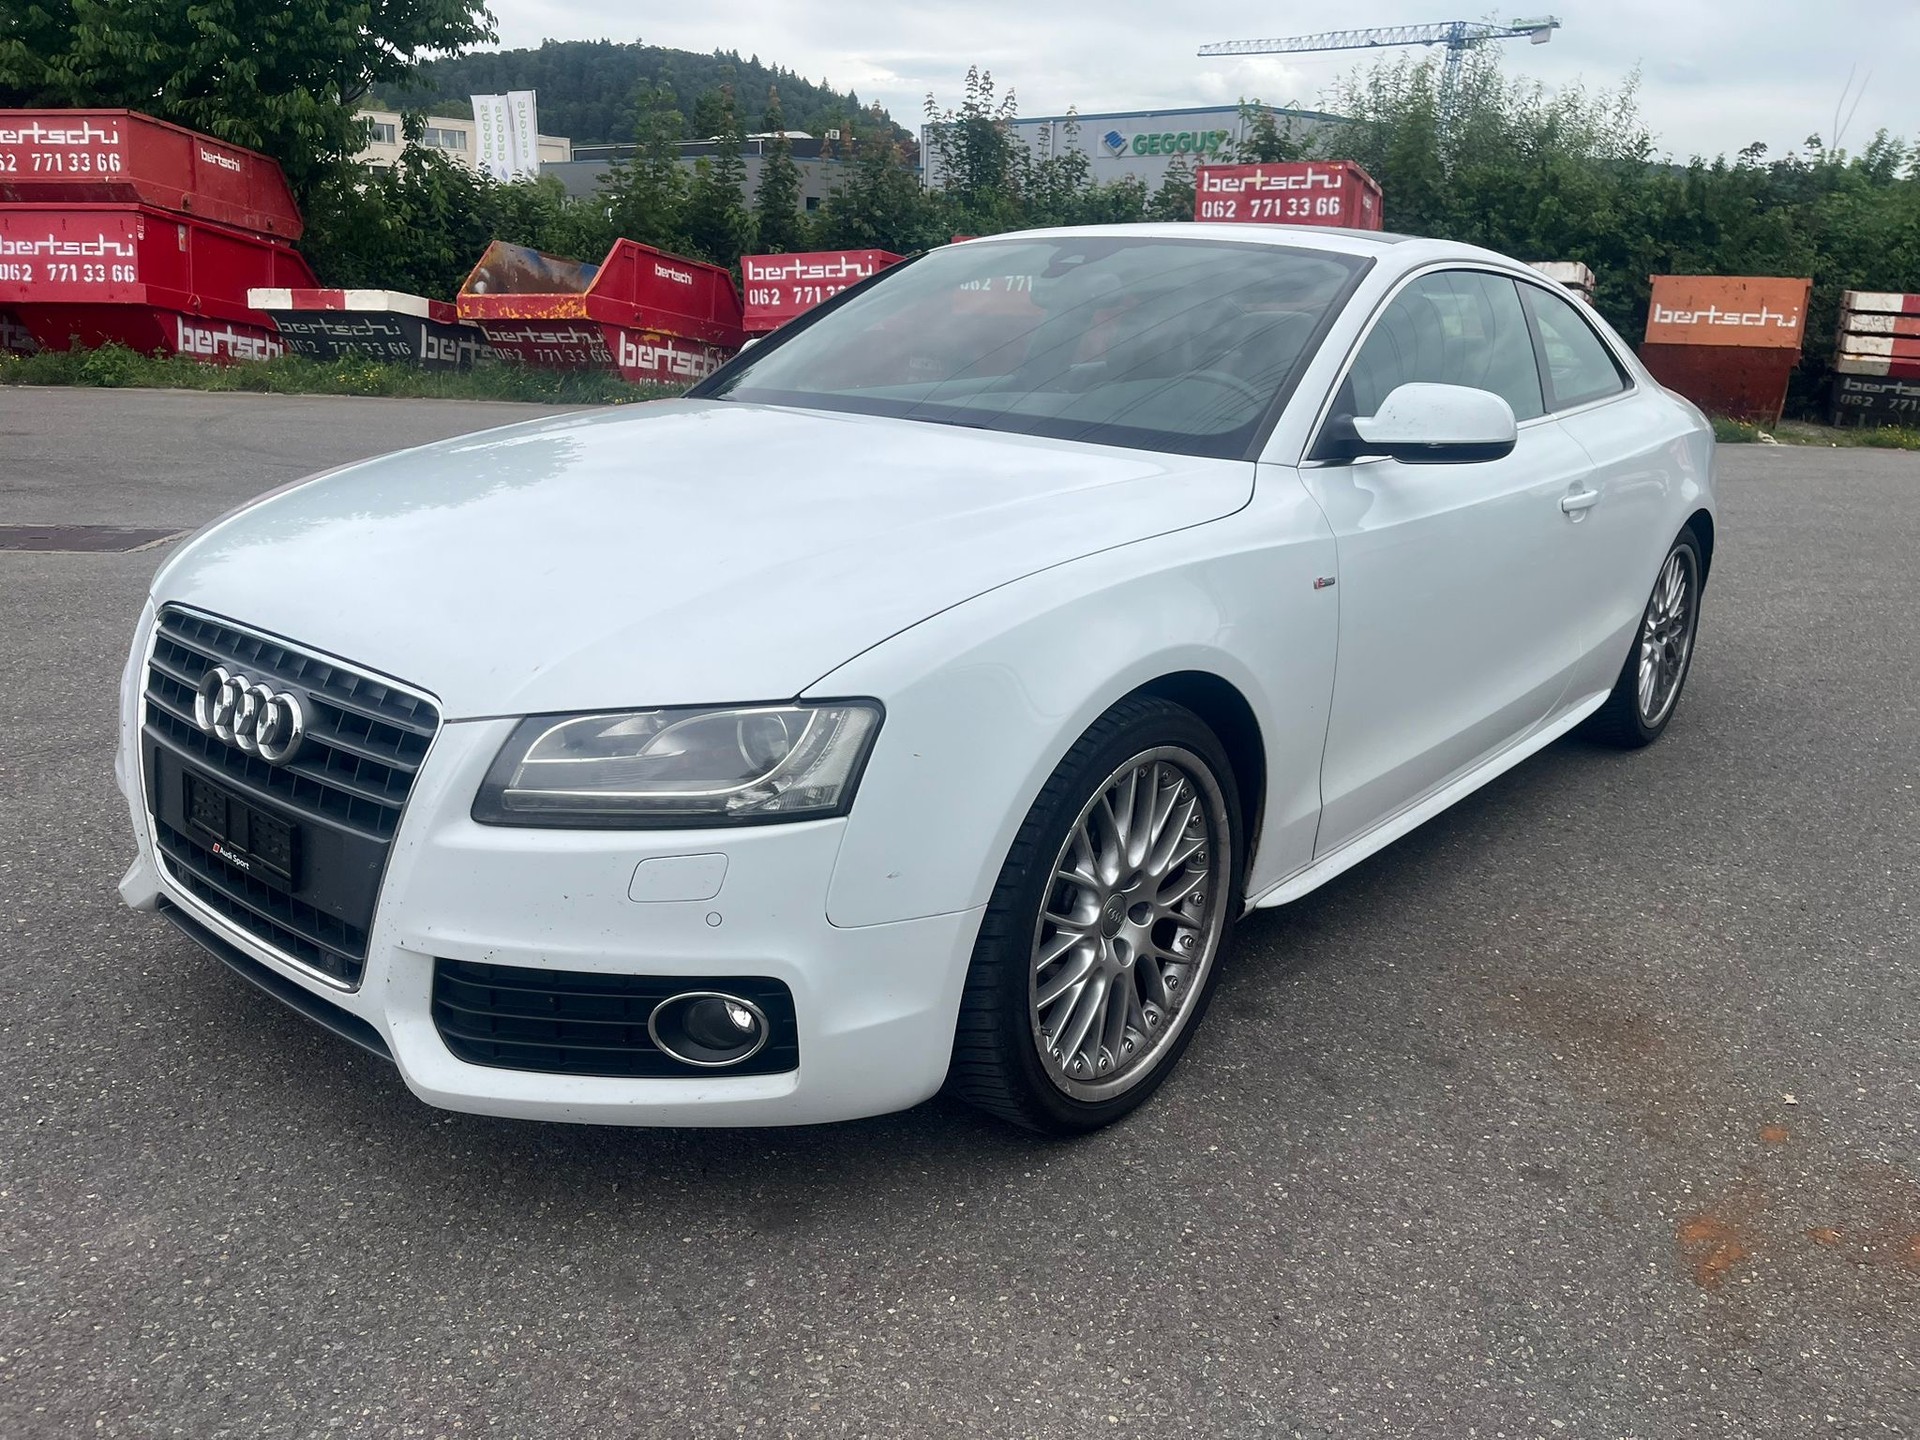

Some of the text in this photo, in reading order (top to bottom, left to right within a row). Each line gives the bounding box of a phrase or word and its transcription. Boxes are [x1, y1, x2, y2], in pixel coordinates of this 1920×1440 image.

[0, 120, 119, 144] ertschi
[1132, 131, 1220, 155] GEGGUS
[31, 153, 62, 172] 771
[68, 153, 91, 172] 33
[97, 153, 121, 172] 66
[200, 147, 241, 172] bertschi
[1203, 166, 1342, 192] bertschi
[1201, 200, 1237, 218] 062
[1250, 198, 1281, 218] 771
[1287, 198, 1310, 217] 33
[1316, 197, 1340, 216] 66
[0, 233, 134, 256] bertschi
[47, 263, 77, 282] 771
[83, 263, 105, 282] 33
[112, 264, 135, 282] 66
[654, 262, 692, 285] bertschi
[748, 254, 873, 280] bertschi
[749, 288, 781, 305] 062
[793, 285, 821, 304] 771
[1004, 275, 1032, 292] 771
[271, 316, 401, 336] bertschi
[1653, 303, 1798, 327] bertschi
[177, 315, 284, 361] bertschi
[480, 325, 604, 343] bertschi
[388, 341, 411, 355] 66
[534, 348, 564, 362] 771
[565, 349, 587, 362] 33
[220, 846, 250, 870] Audi Sport
